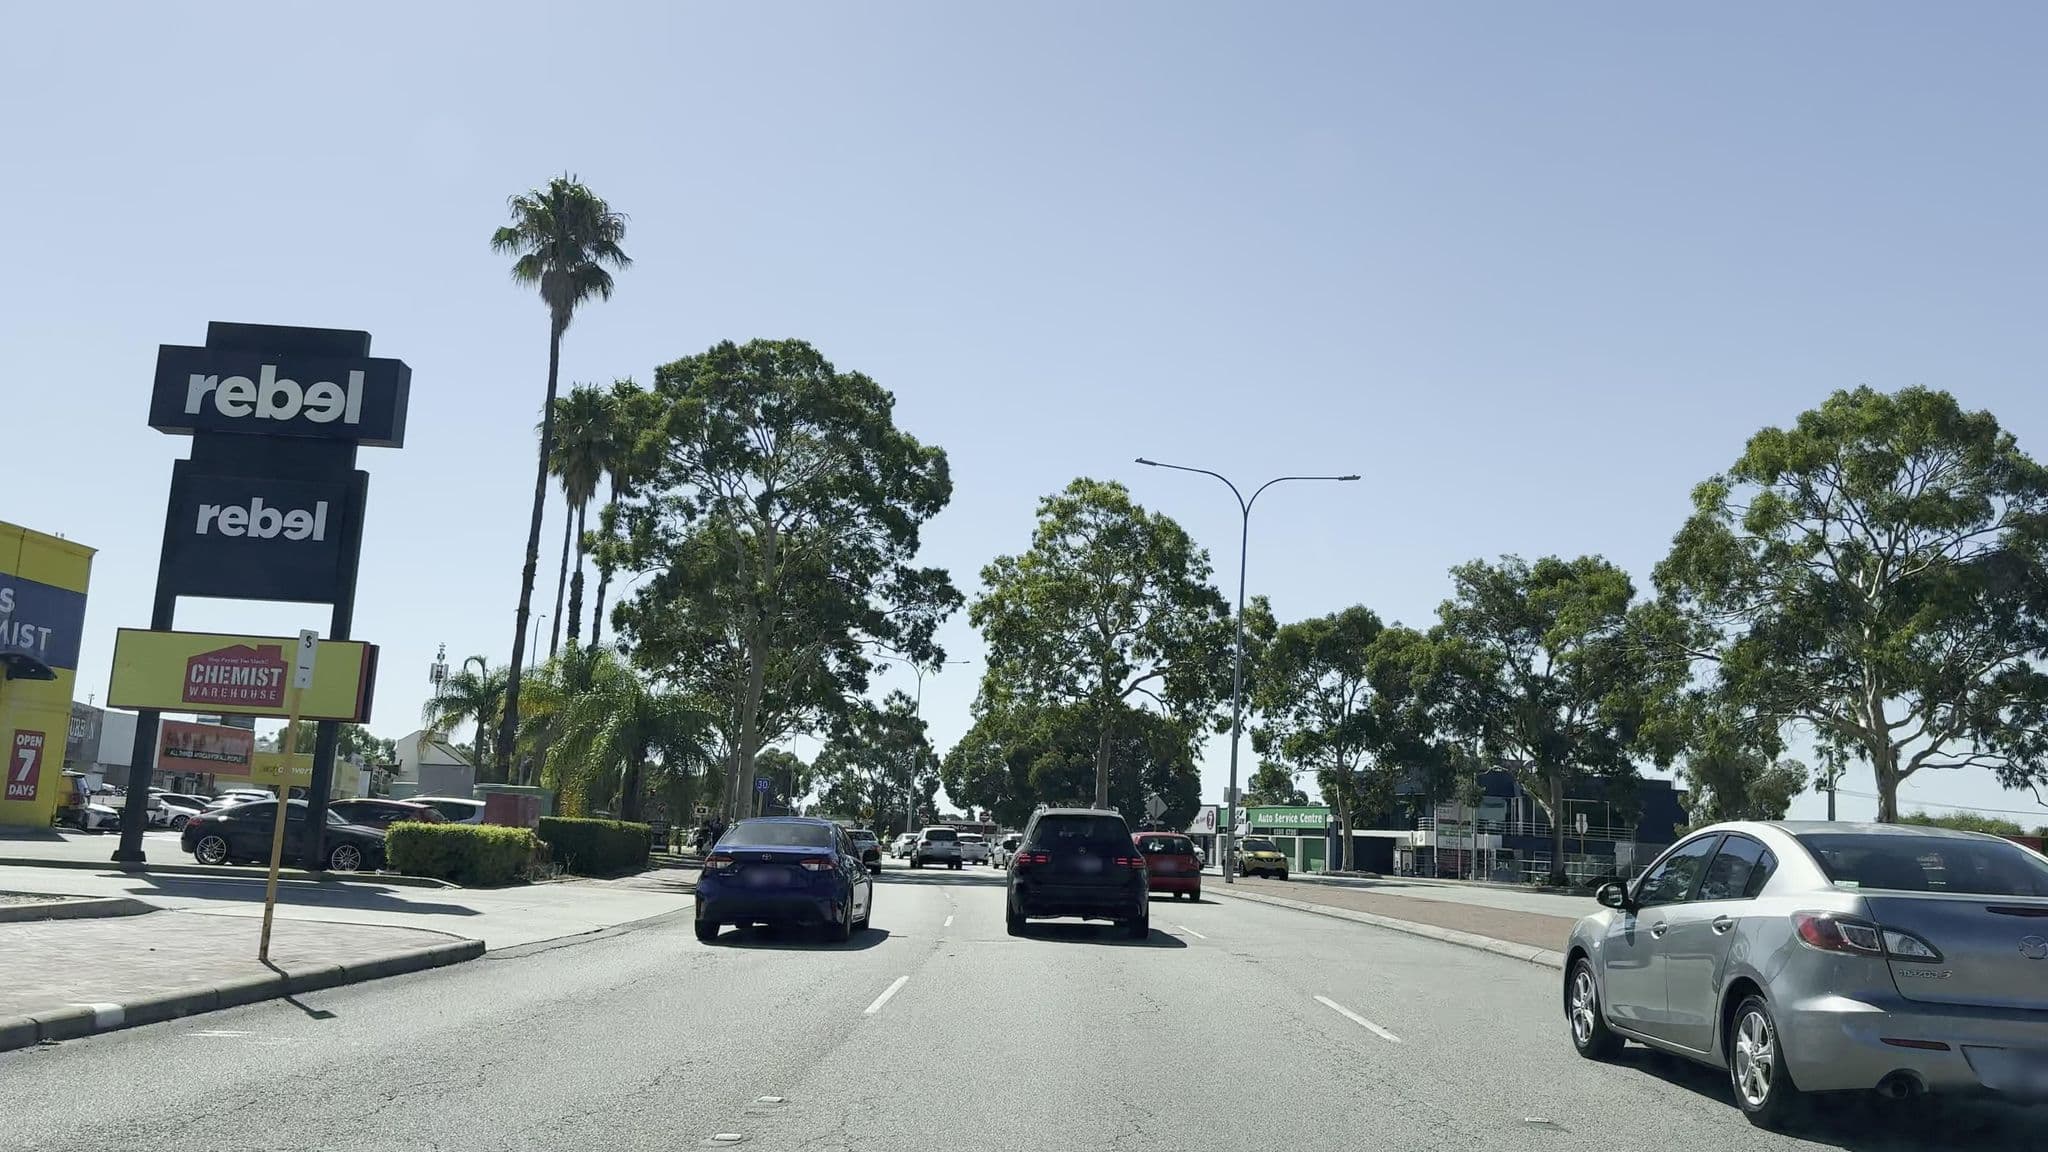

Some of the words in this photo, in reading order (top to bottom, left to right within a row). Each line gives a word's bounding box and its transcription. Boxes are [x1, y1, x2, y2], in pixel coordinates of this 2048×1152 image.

[184, 364, 365, 424] rebel
[195, 497, 328, 541] rebel
[190, 663, 282, 687] CHEMIST
[189, 685, 277, 700] WAREHOUSE
[16, 734, 43, 747] OPEN
[16, 748, 36, 782] 7
[8, 784, 35, 796] DAYS
[757, 780, 768, 789] 30
[1258, 813, 1273, 823] Auto
[1275, 813, 1298, 823] Service
[1300, 813, 1322, 823] Centre
